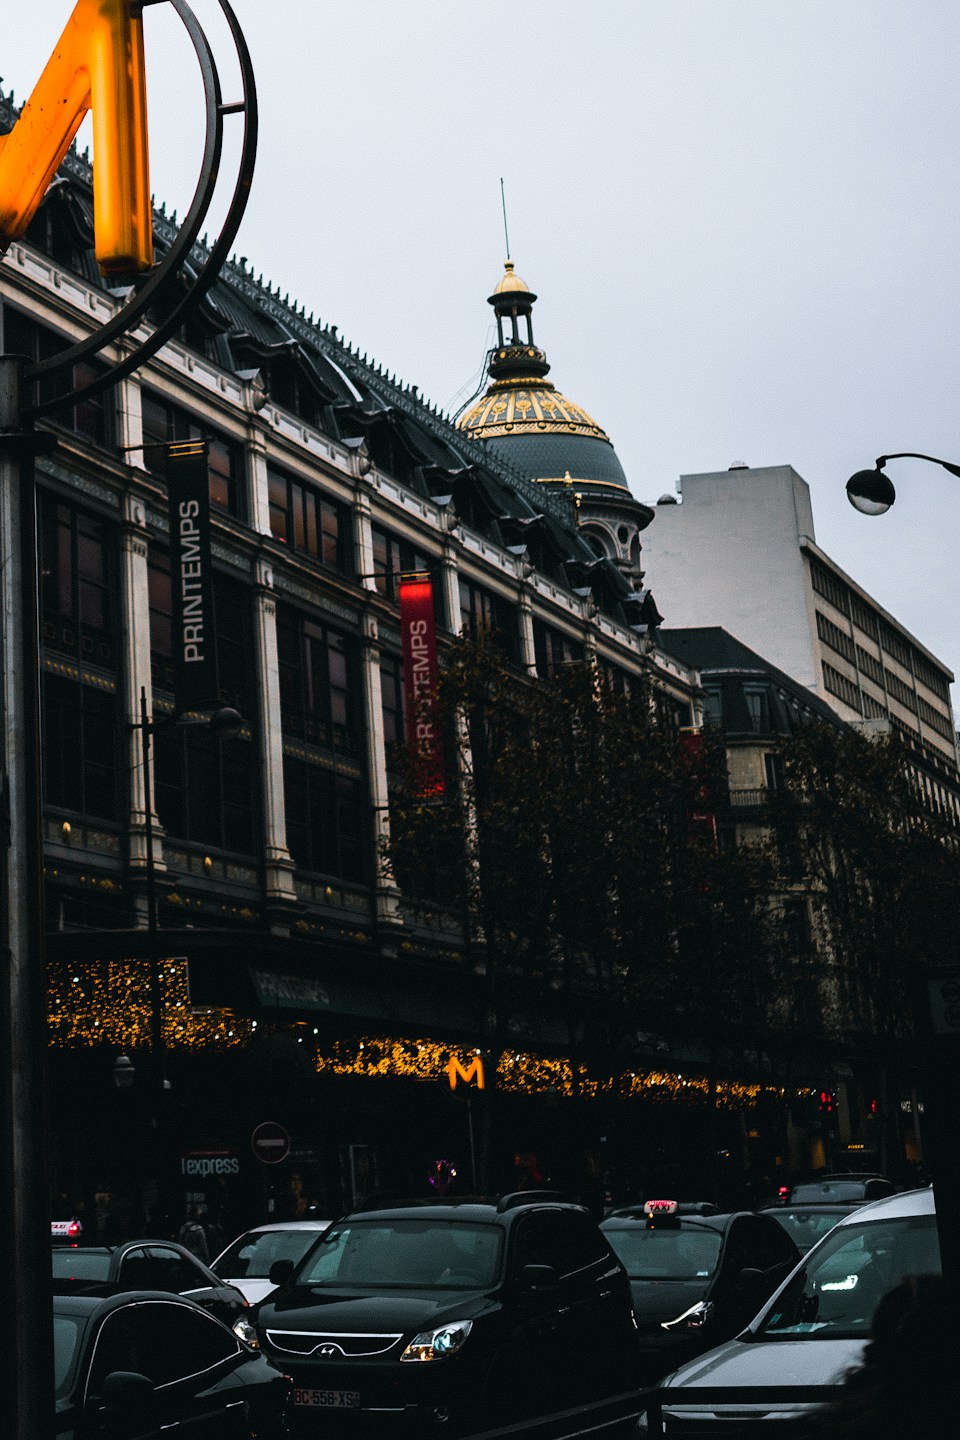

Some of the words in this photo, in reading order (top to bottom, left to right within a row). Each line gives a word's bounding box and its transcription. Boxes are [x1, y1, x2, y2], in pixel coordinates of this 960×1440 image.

[179, 499, 205, 663] PRINTEMPS
[409, 619, 436, 760] PRTEMPS
[448, 1055, 486, 1092] M
